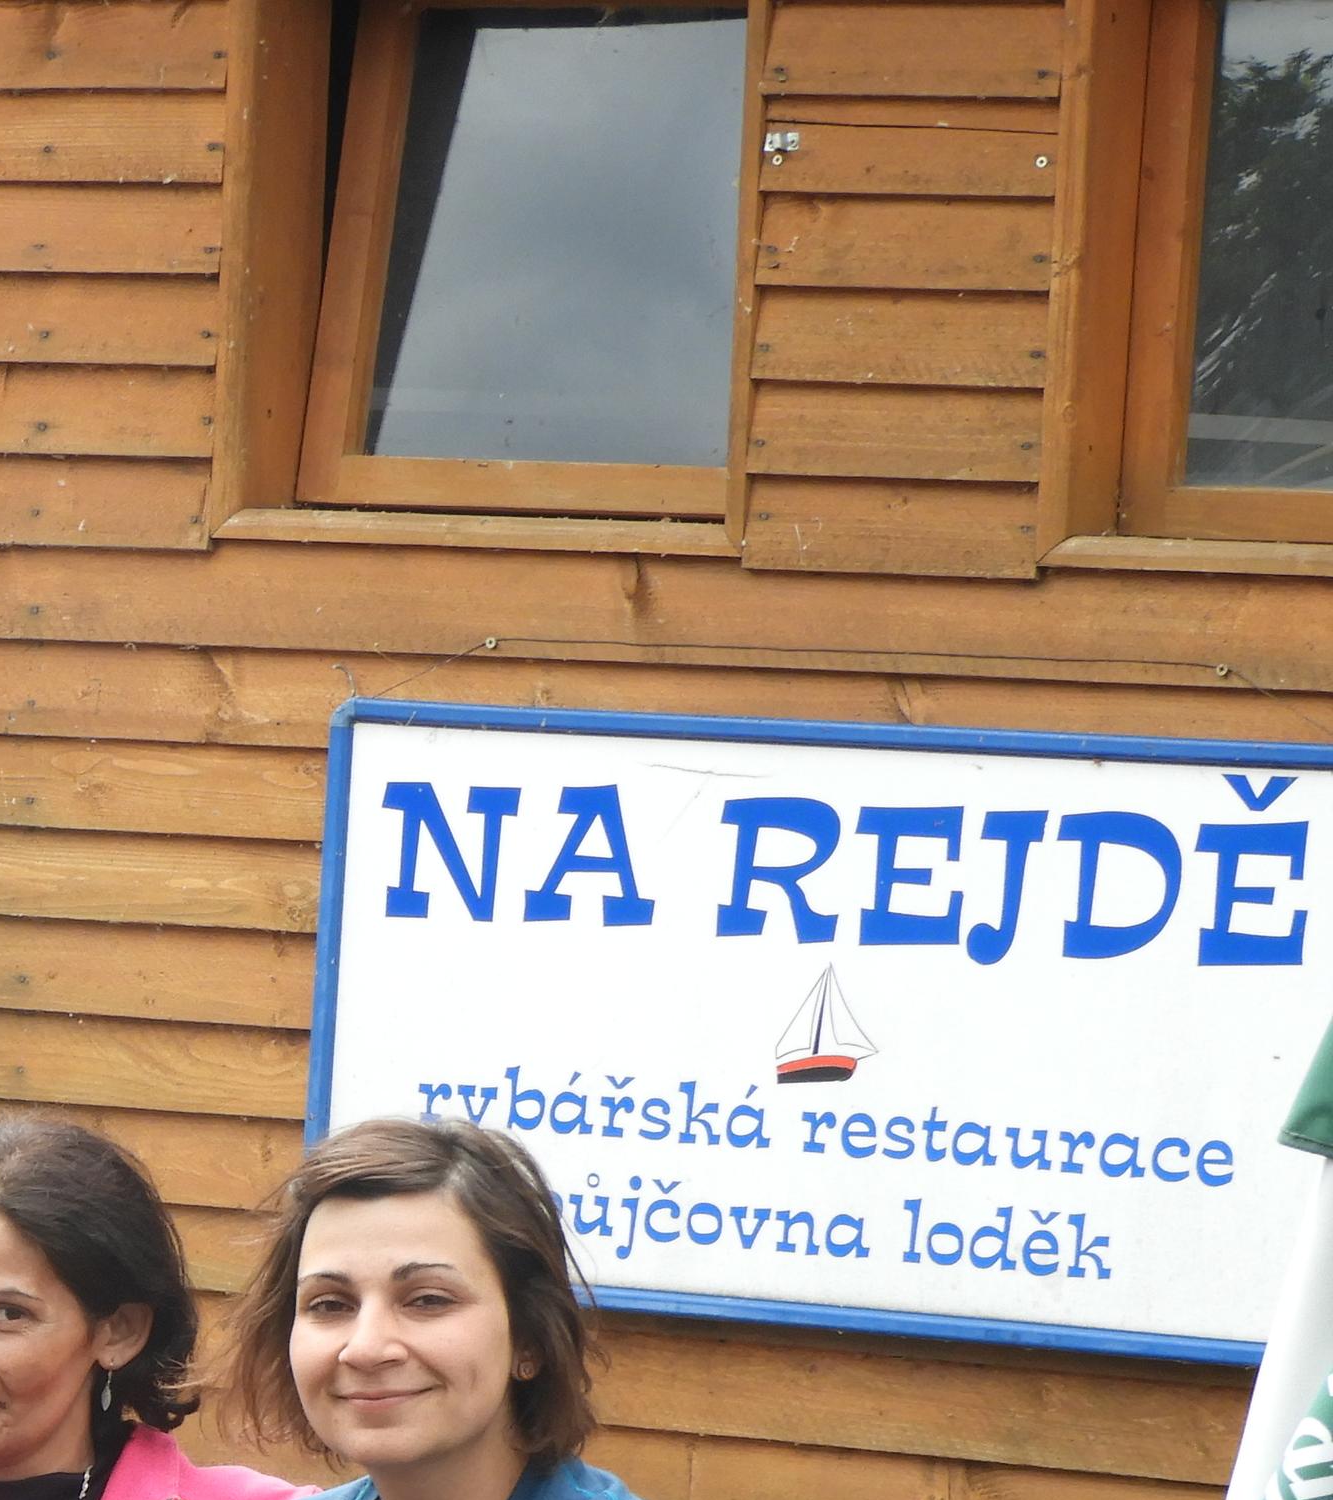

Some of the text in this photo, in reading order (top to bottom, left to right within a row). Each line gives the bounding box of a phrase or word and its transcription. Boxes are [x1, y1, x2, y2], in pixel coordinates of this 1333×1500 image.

[382, 774, 1310, 966] NA REJDĚ
[801, 1106, 1235, 1187] restaurace
[549, 1173, 1112, 1280] ůjčovna loděk
